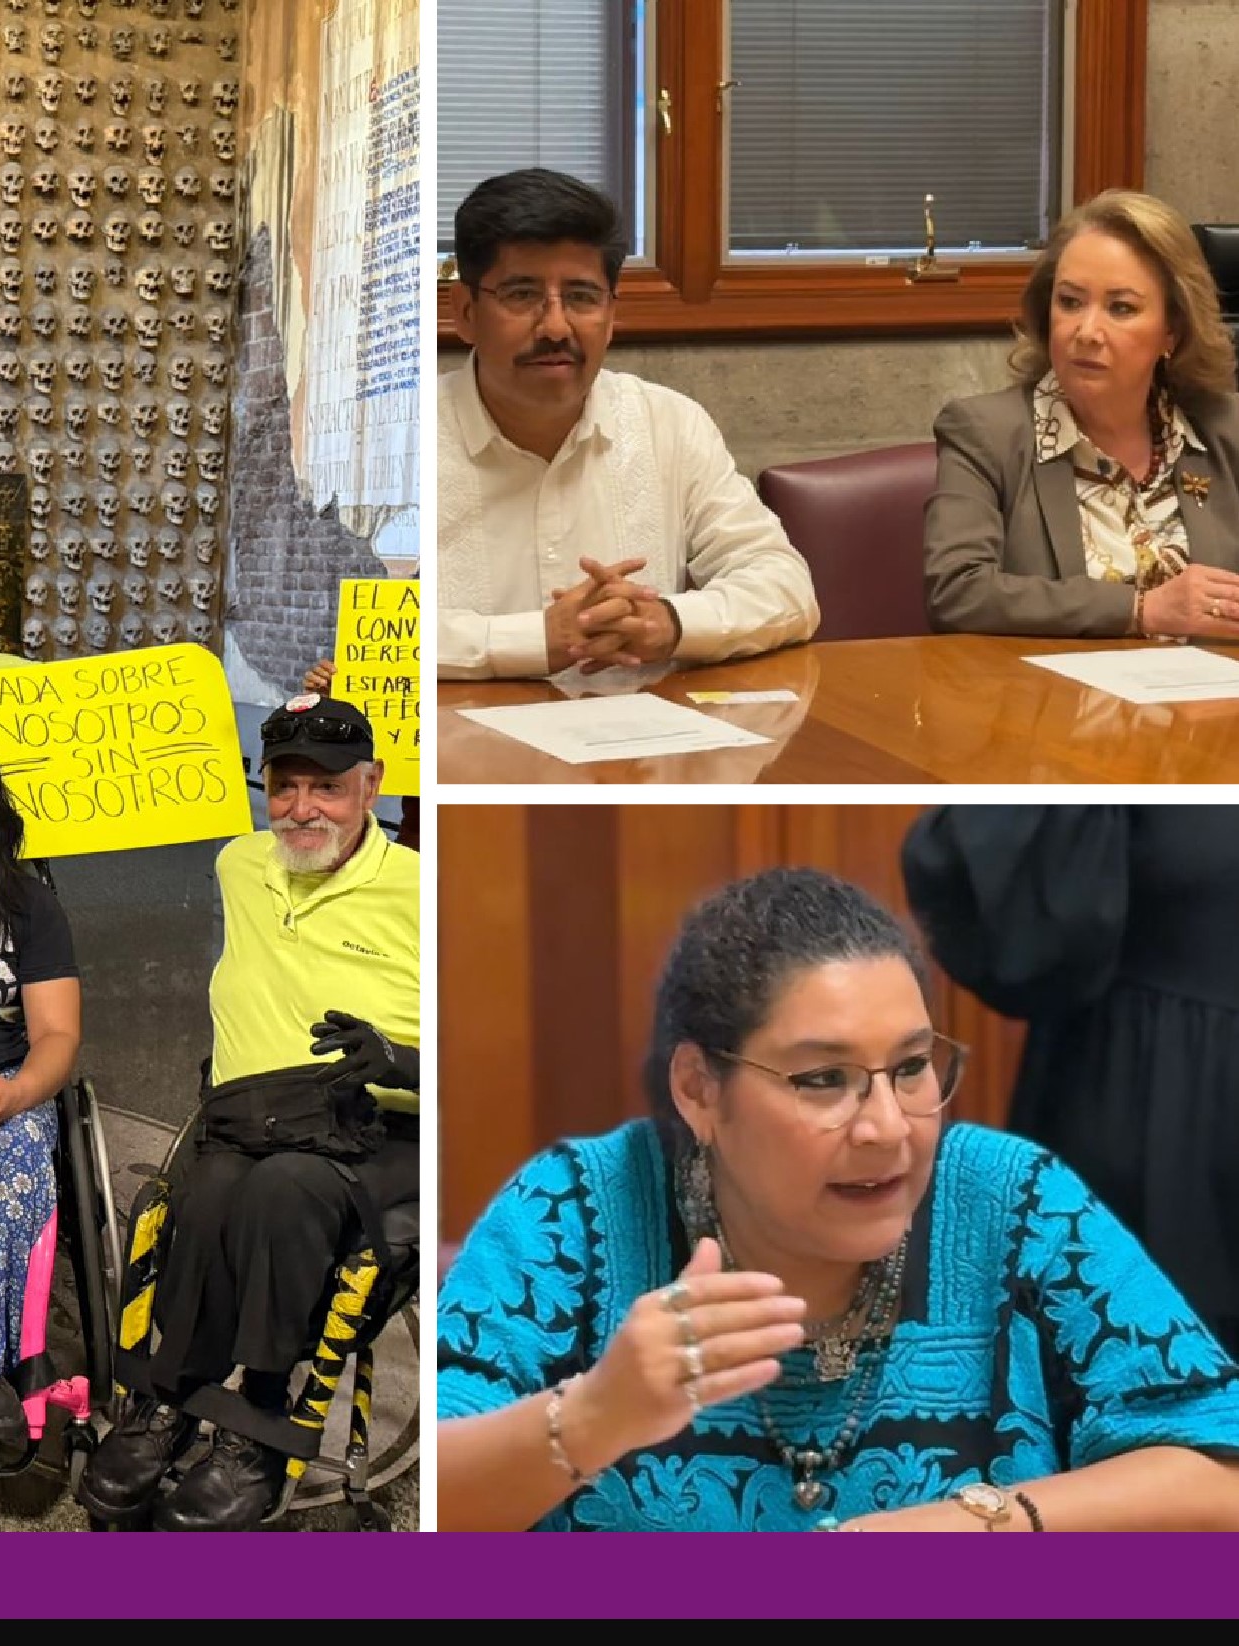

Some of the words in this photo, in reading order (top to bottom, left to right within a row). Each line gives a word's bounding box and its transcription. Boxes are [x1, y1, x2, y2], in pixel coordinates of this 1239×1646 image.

[352, 583, 383, 609] EL
[74, 656, 195, 700] SOBRE
[72, 743, 140, 778] SIN
[6, 758, 227, 823] NOSOTROS
